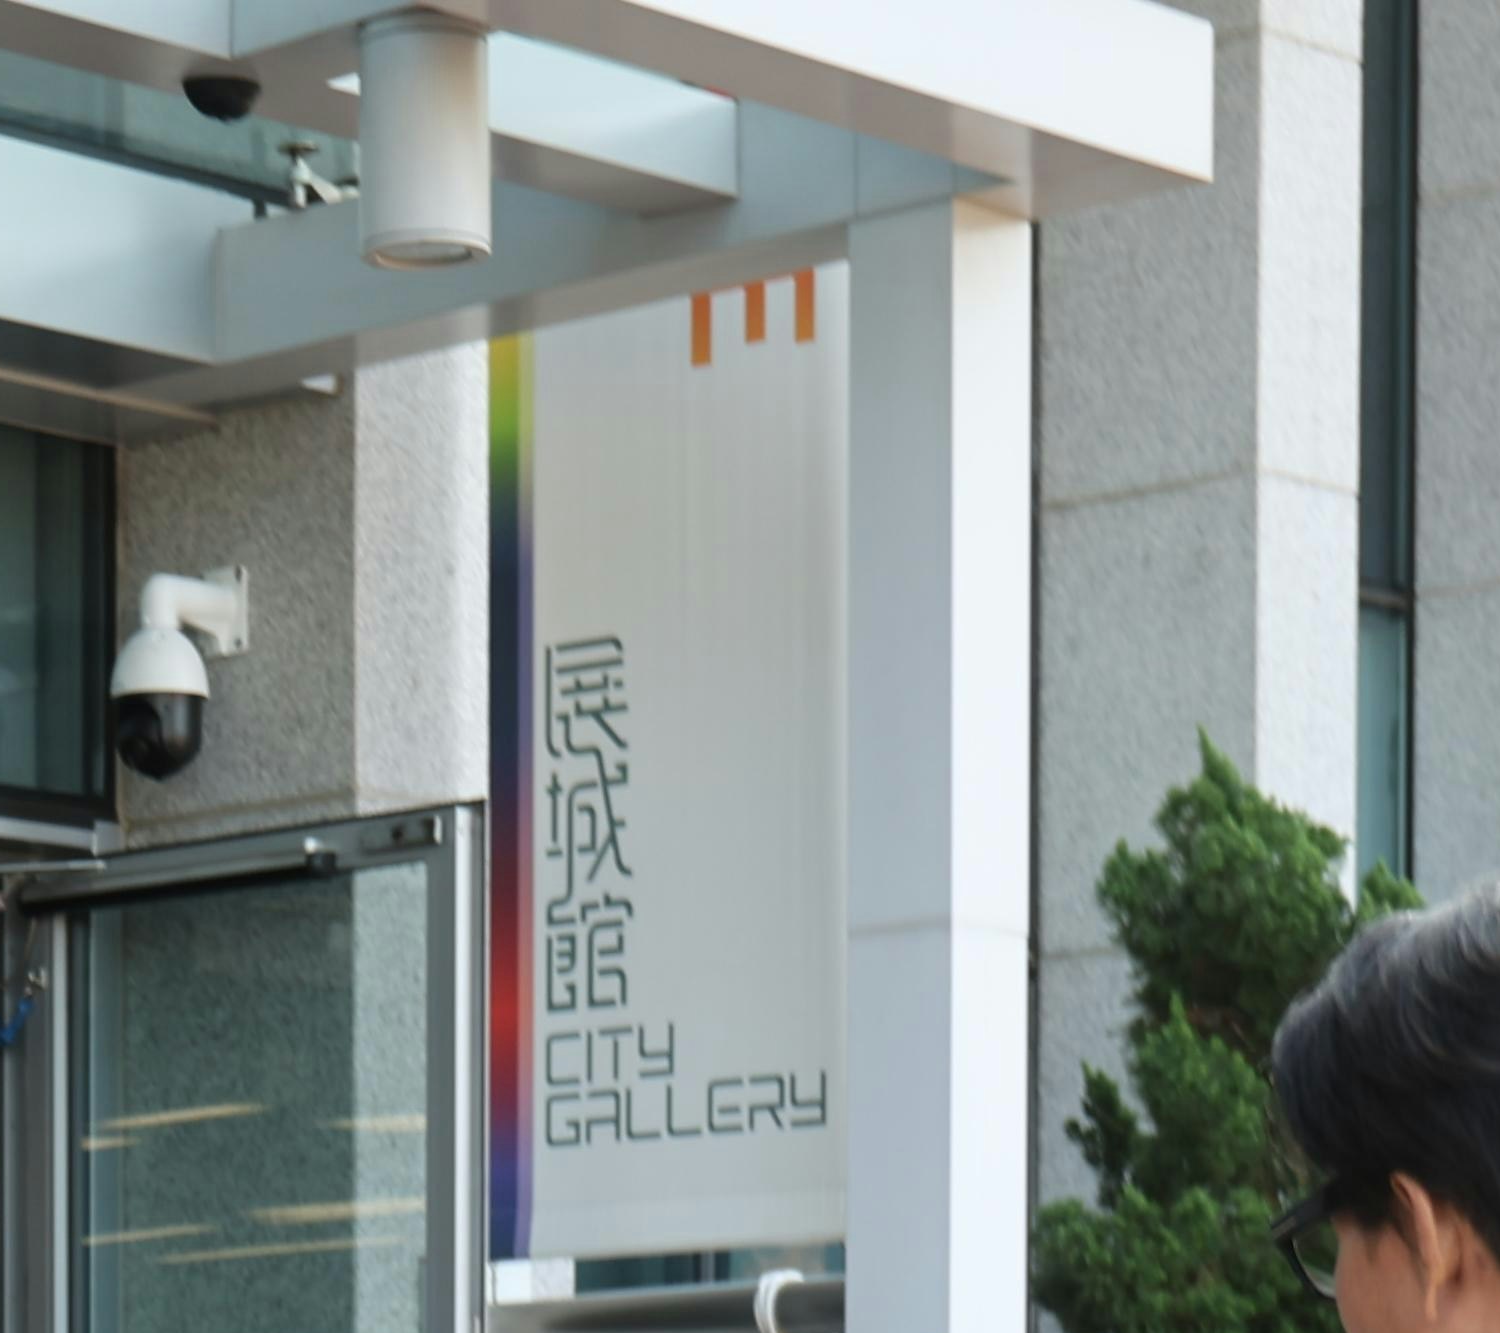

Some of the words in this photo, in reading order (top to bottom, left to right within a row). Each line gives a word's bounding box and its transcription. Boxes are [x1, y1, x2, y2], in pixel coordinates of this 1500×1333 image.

[545, 635, 633, 1013] 展城館
[545, 1021, 675, 1087] CITY
[545, 1069, 827, 1148] GALLERY
